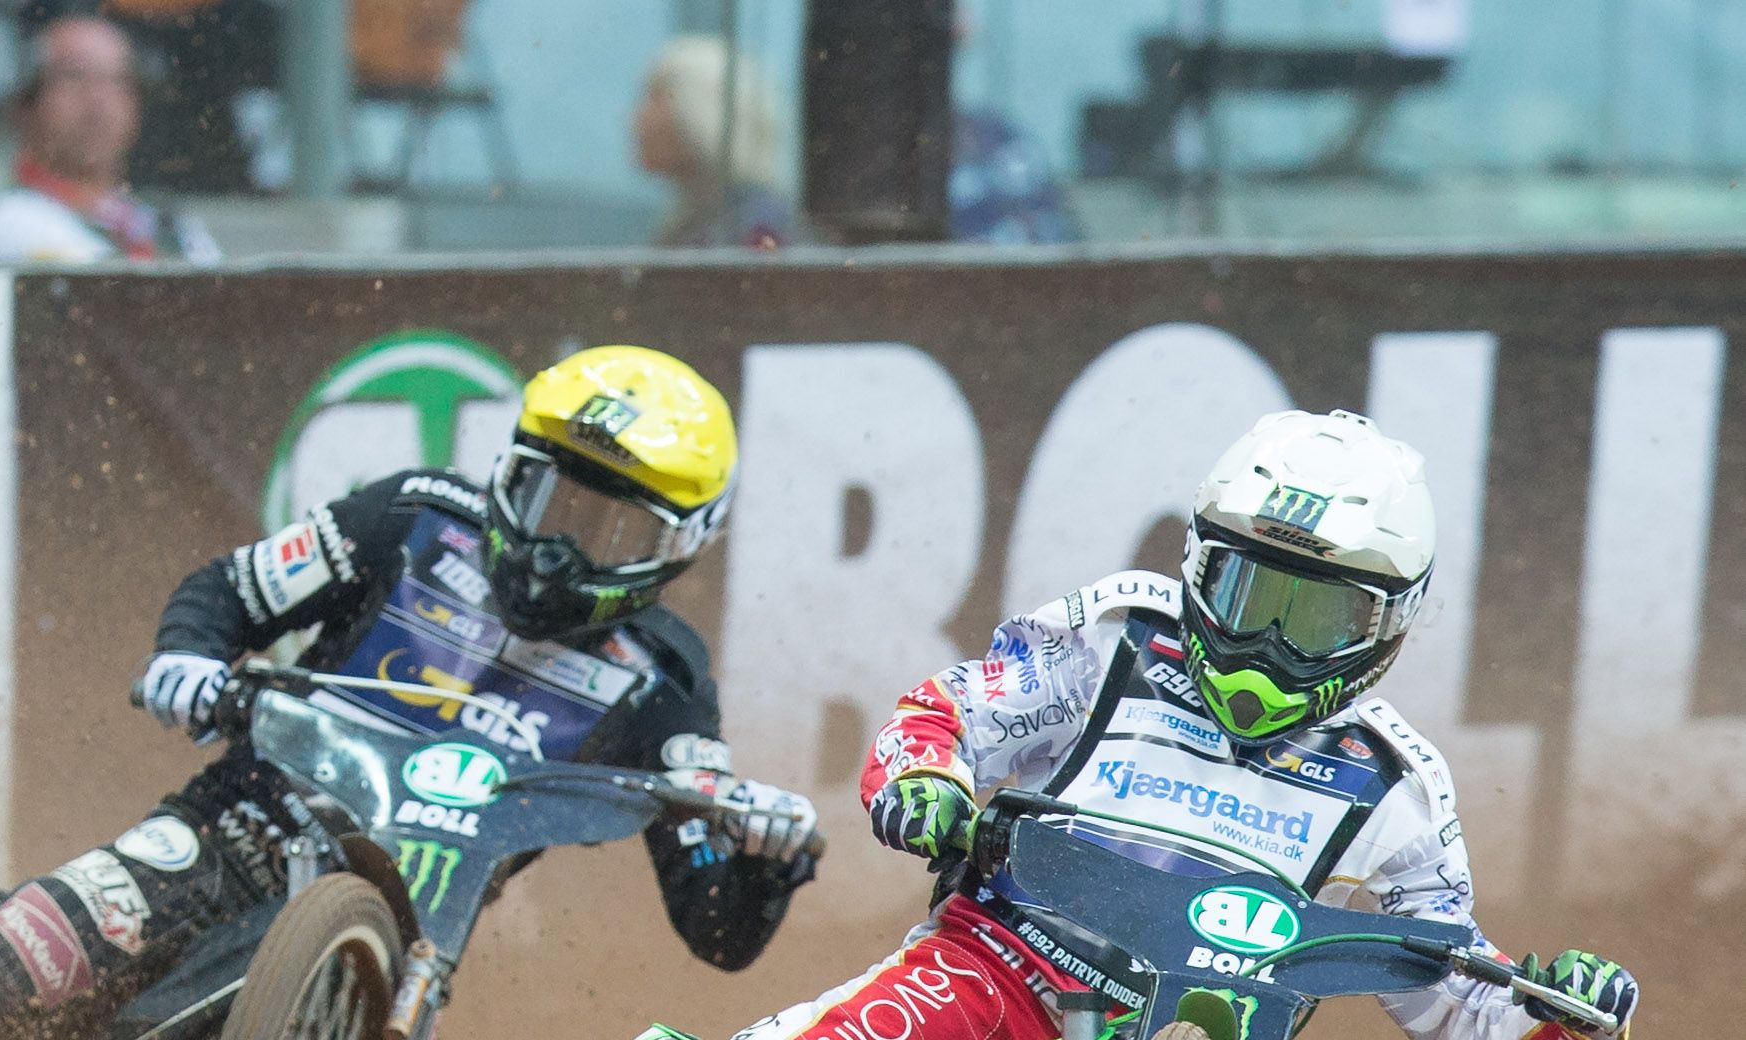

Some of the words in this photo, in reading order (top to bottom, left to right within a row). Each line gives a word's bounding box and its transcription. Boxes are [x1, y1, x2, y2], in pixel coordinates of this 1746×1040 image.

[1298, 761, 1338, 784] GLS
[394, 799, 480, 838] BOLL
[1090, 757, 1314, 844] Kjærgaard
[1211, 818, 1305, 863] www.kia.dk
[1016, 921, 1056, 957] #692
[1051, 946, 1107, 991] PATRYK
[1102, 975, 1148, 1011] DUDEK
[1185, 945, 1276, 985] BOLL
